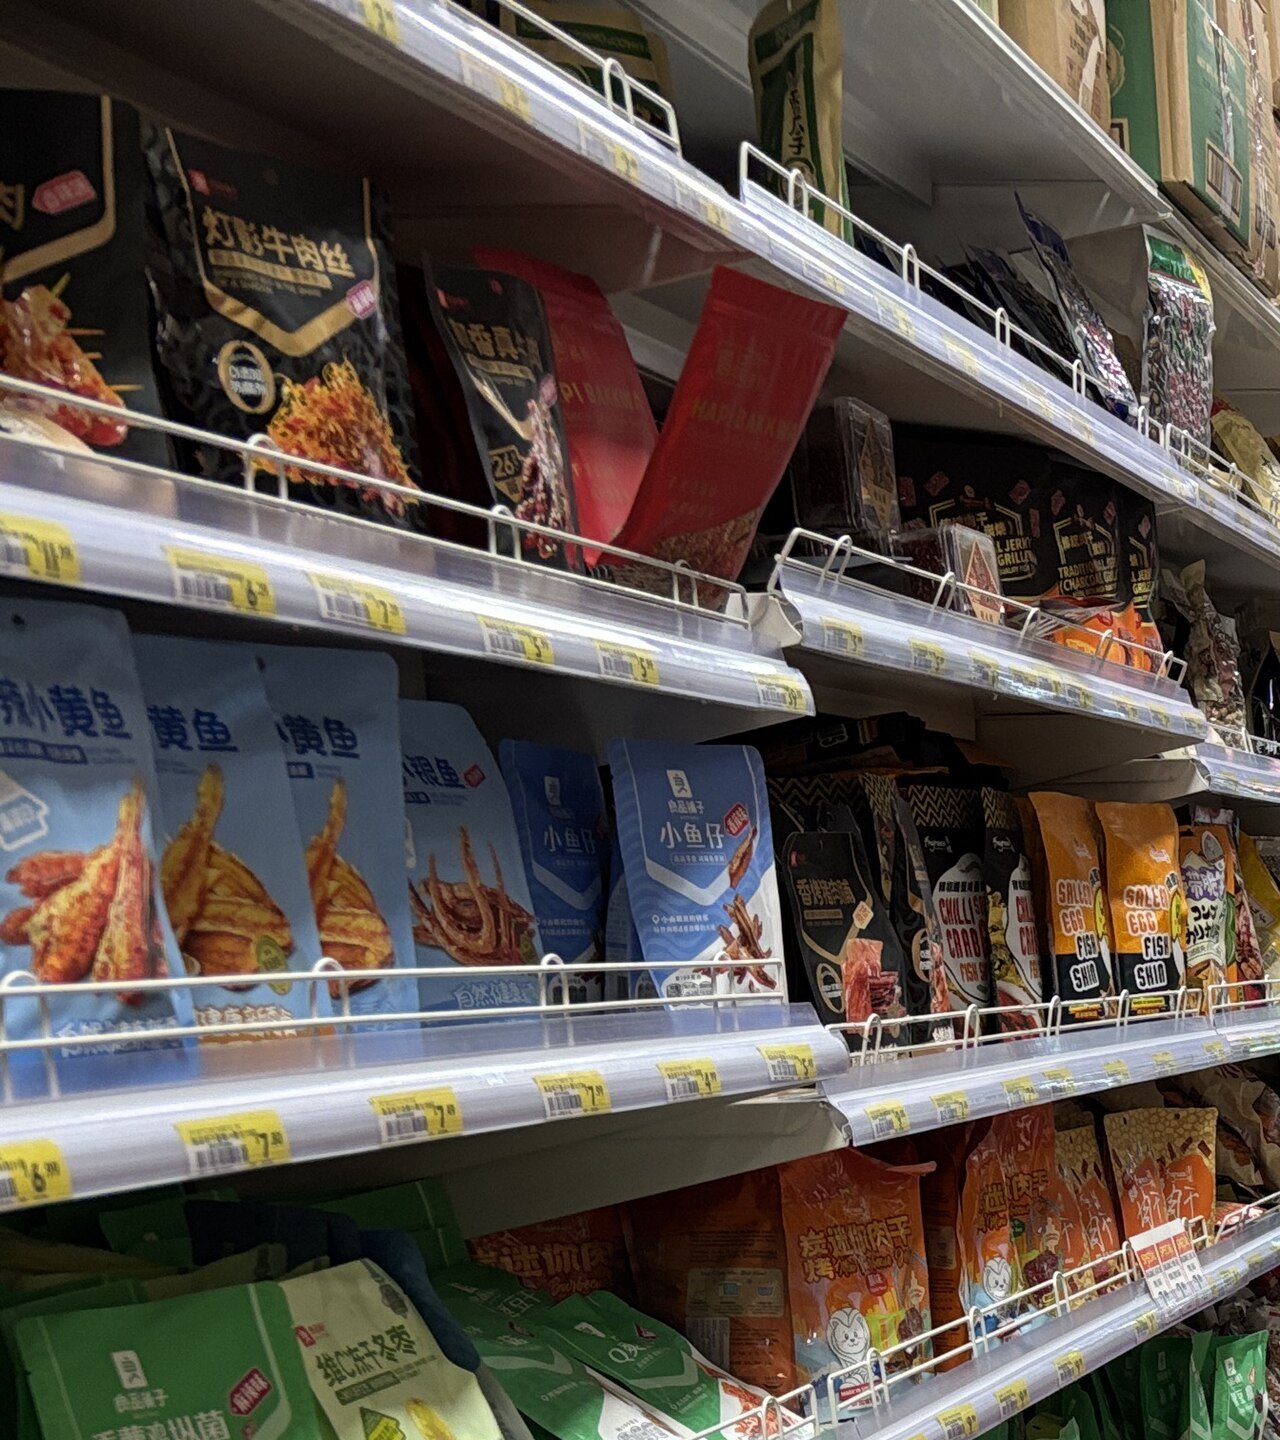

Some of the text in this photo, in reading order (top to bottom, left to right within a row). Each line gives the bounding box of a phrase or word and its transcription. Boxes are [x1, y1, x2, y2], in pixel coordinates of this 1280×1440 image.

[276, 712, 361, 760] 黄鱼
[660, 820, 726, 850] 小鱼仔
[1126, 910, 1157, 935] EGG
[1077, 934, 1098, 960] FISH
[1143, 934, 1171, 960] FISH
